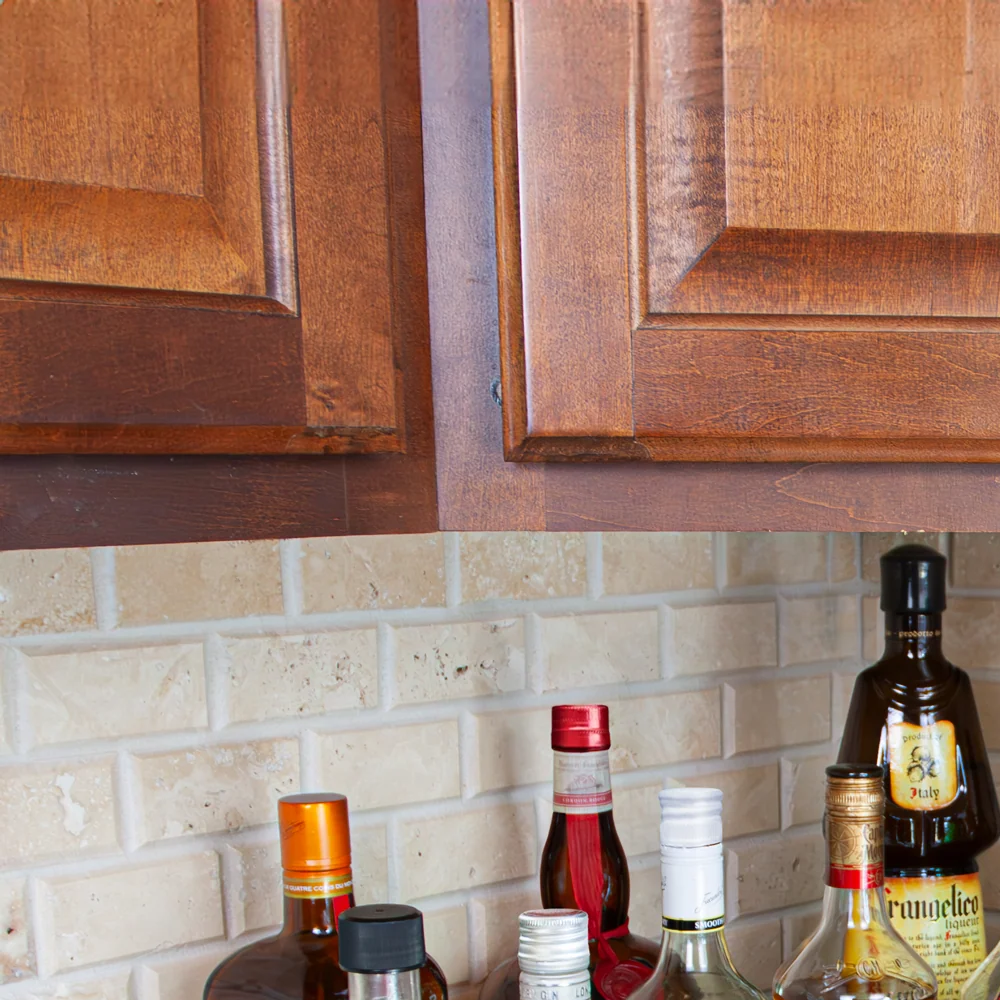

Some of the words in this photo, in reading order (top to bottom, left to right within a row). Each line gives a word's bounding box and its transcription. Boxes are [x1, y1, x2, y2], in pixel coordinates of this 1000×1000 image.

[910, 787, 940, 801] Italy
[885, 883, 979, 922] rangelico
[945, 917, 979, 930] liqueur
